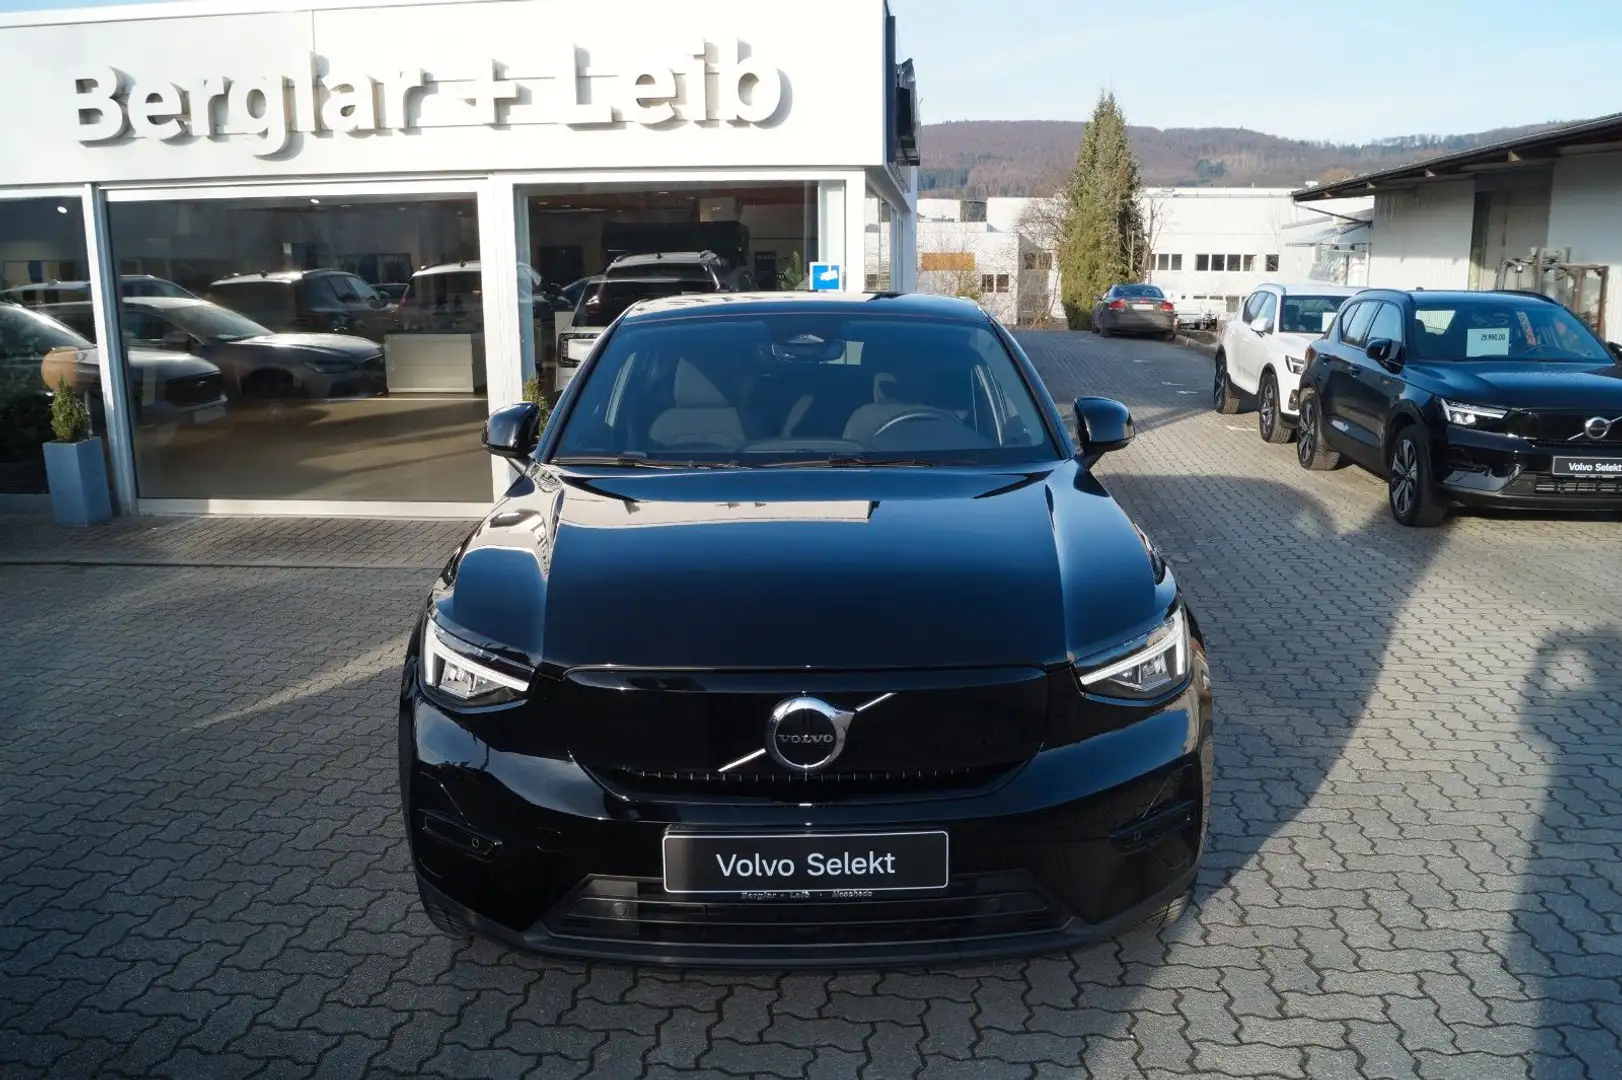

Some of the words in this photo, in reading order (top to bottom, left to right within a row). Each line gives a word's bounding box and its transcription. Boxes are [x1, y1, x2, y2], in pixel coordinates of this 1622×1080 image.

[63, 50, 431, 160] Berglar
[456, 56, 524, 128] +
[562, 36, 788, 129] Leib
[1568, 462, 1593, 471] Volvo
[1595, 463, 1622, 472] Selekt
[777, 733, 834, 744] VOLVO
[715, 853, 795, 877] Volvo
[806, 851, 896, 876] Selekt
